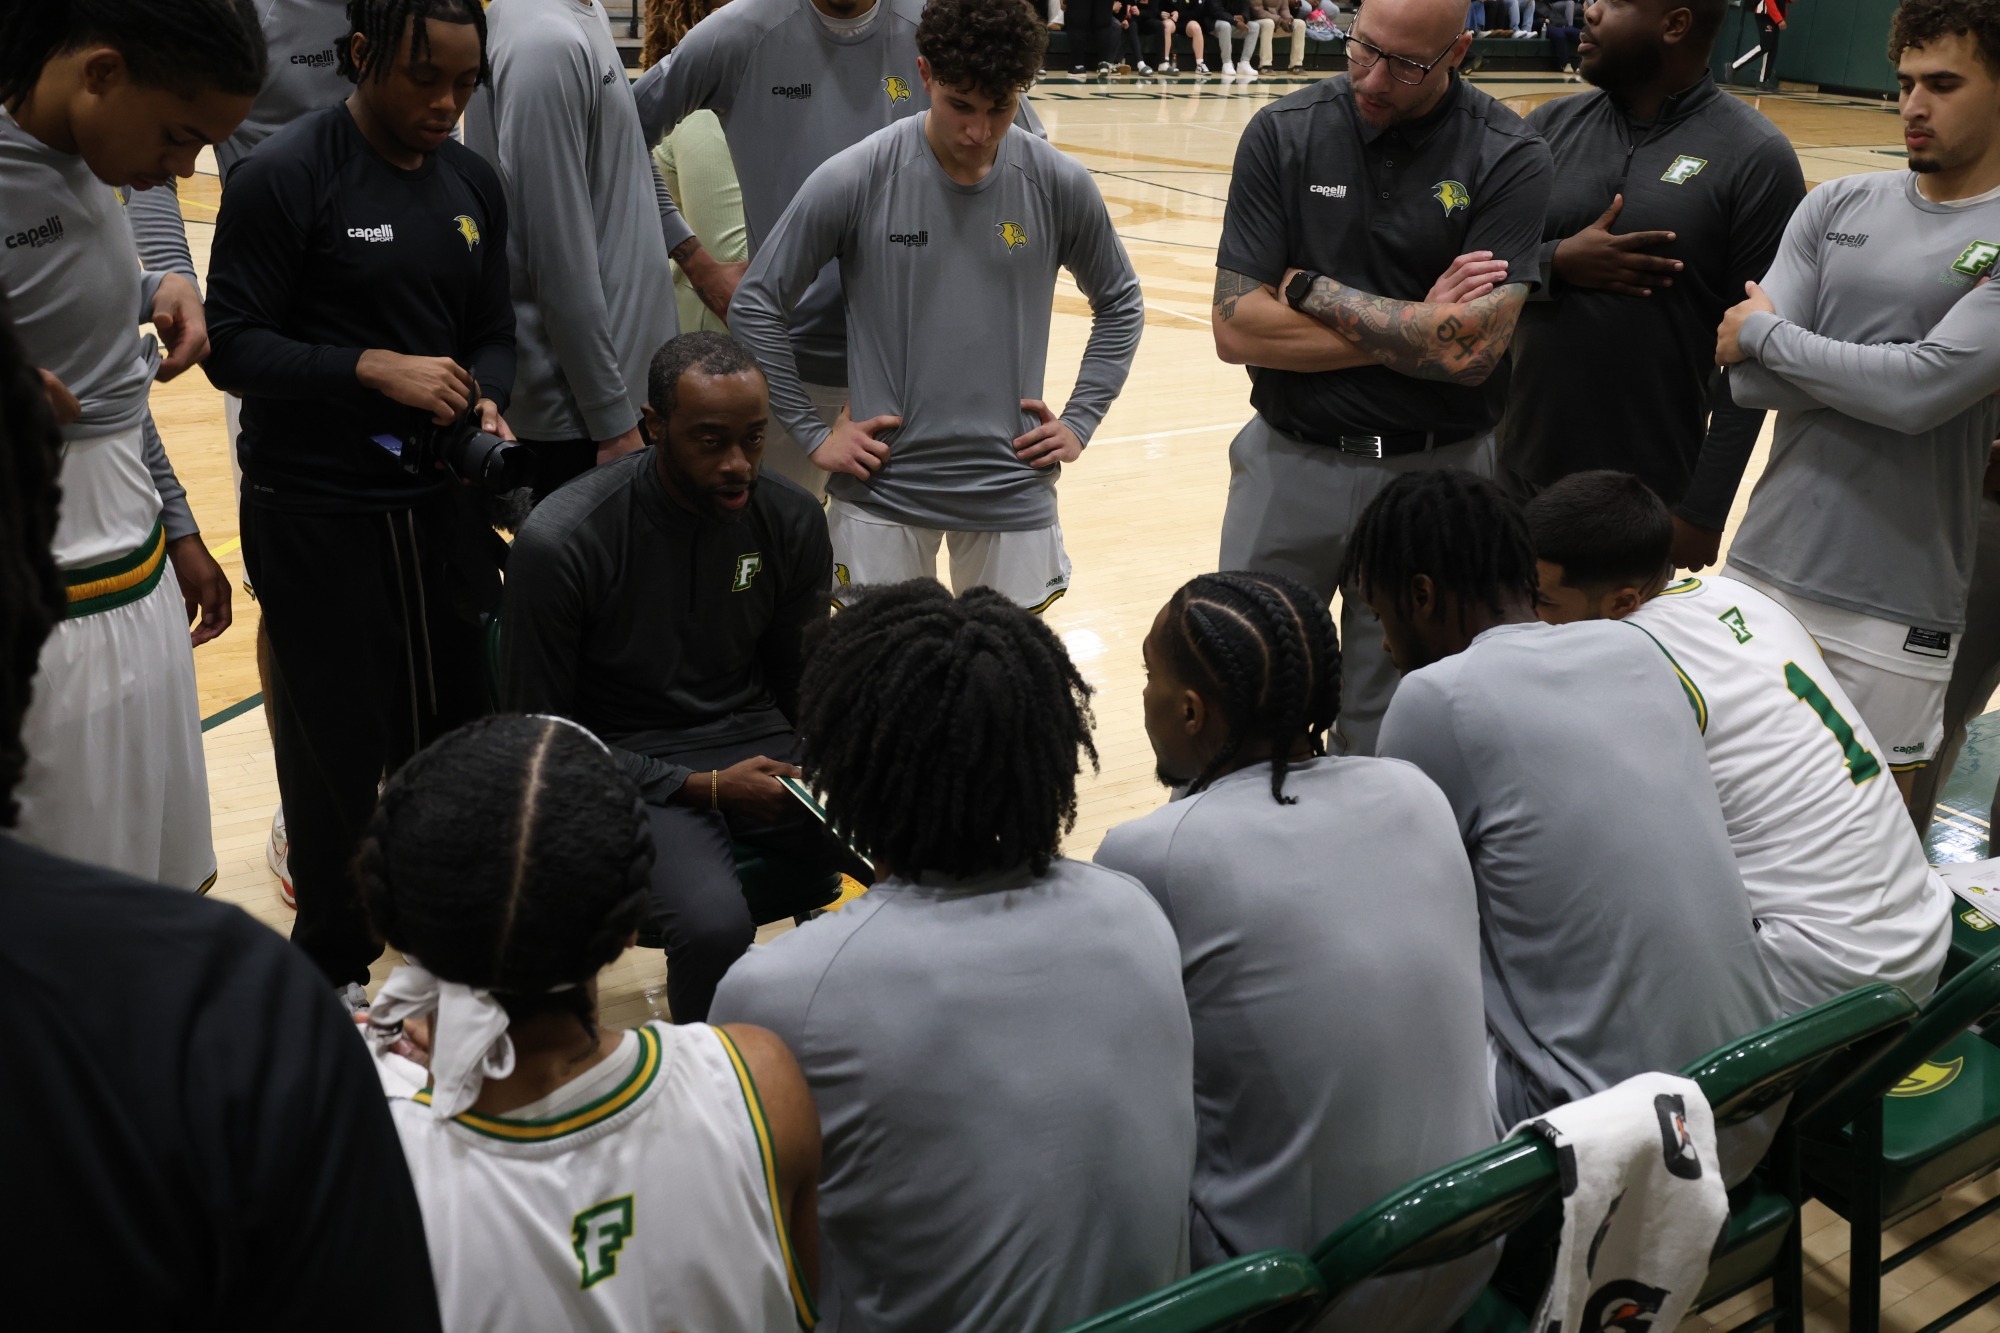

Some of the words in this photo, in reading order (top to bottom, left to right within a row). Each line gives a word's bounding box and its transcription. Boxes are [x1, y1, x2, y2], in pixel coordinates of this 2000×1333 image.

[290, 50, 334, 67] capelli
[771, 83, 812, 98] capelli
[1660, 154, 1709, 185] F
[1309, 184, 1347, 196] capelli
[5, 215, 64, 249] capelli
[347, 223, 394, 241] capelli
[889, 230, 929, 246] capelli
[1950, 239, 2000, 276] F
[1436, 314, 1482, 362] 54
[731, 551, 762, 592] F
[1717, 605, 1755, 645] F
[1782, 659, 1882, 789] 1
[569, 1191, 635, 1292] F
